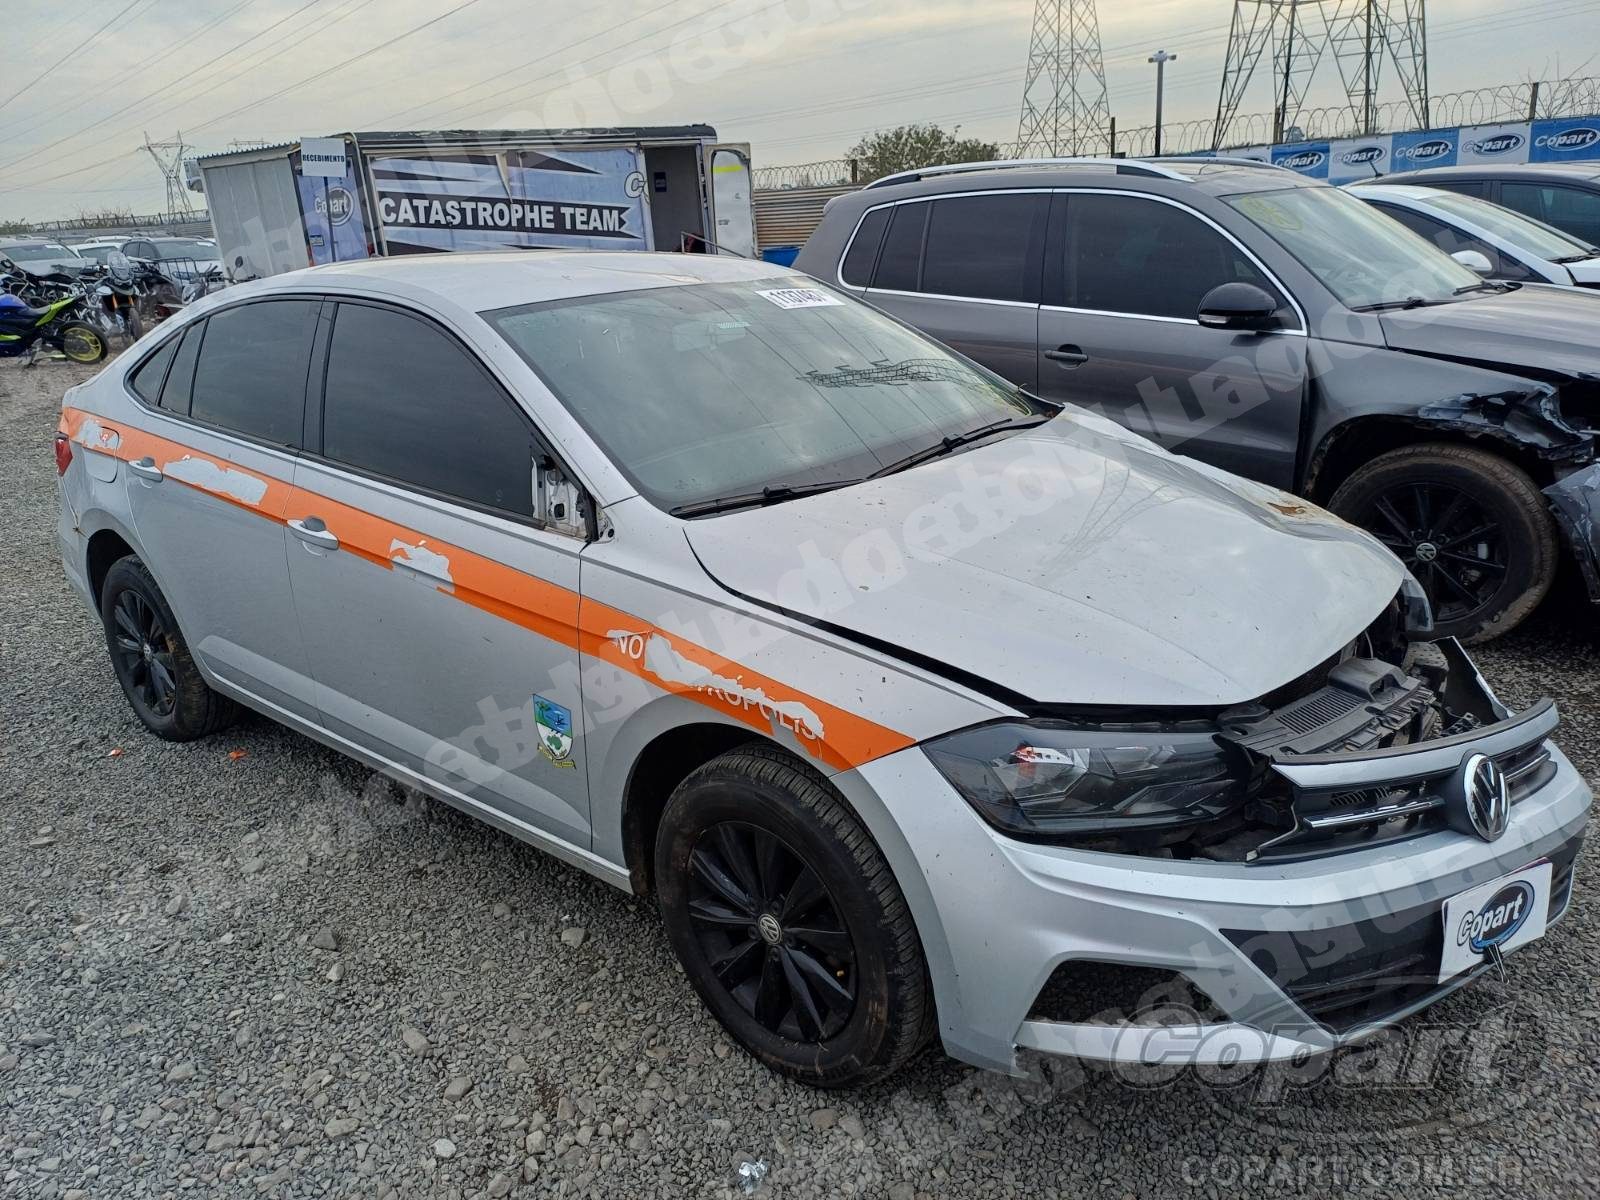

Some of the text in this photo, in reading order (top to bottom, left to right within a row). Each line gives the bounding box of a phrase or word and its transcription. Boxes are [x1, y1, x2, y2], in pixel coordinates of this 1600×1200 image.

[1534, 132, 1594, 149] Copart
[302, 154, 345, 162] RECEBIMENTO
[1395, 143, 1446, 159] Copart
[1275, 154, 1320, 168] Copart
[379, 197, 620, 231] CATASTROPHE TEAM
[1457, 893, 1524, 946] Copart
